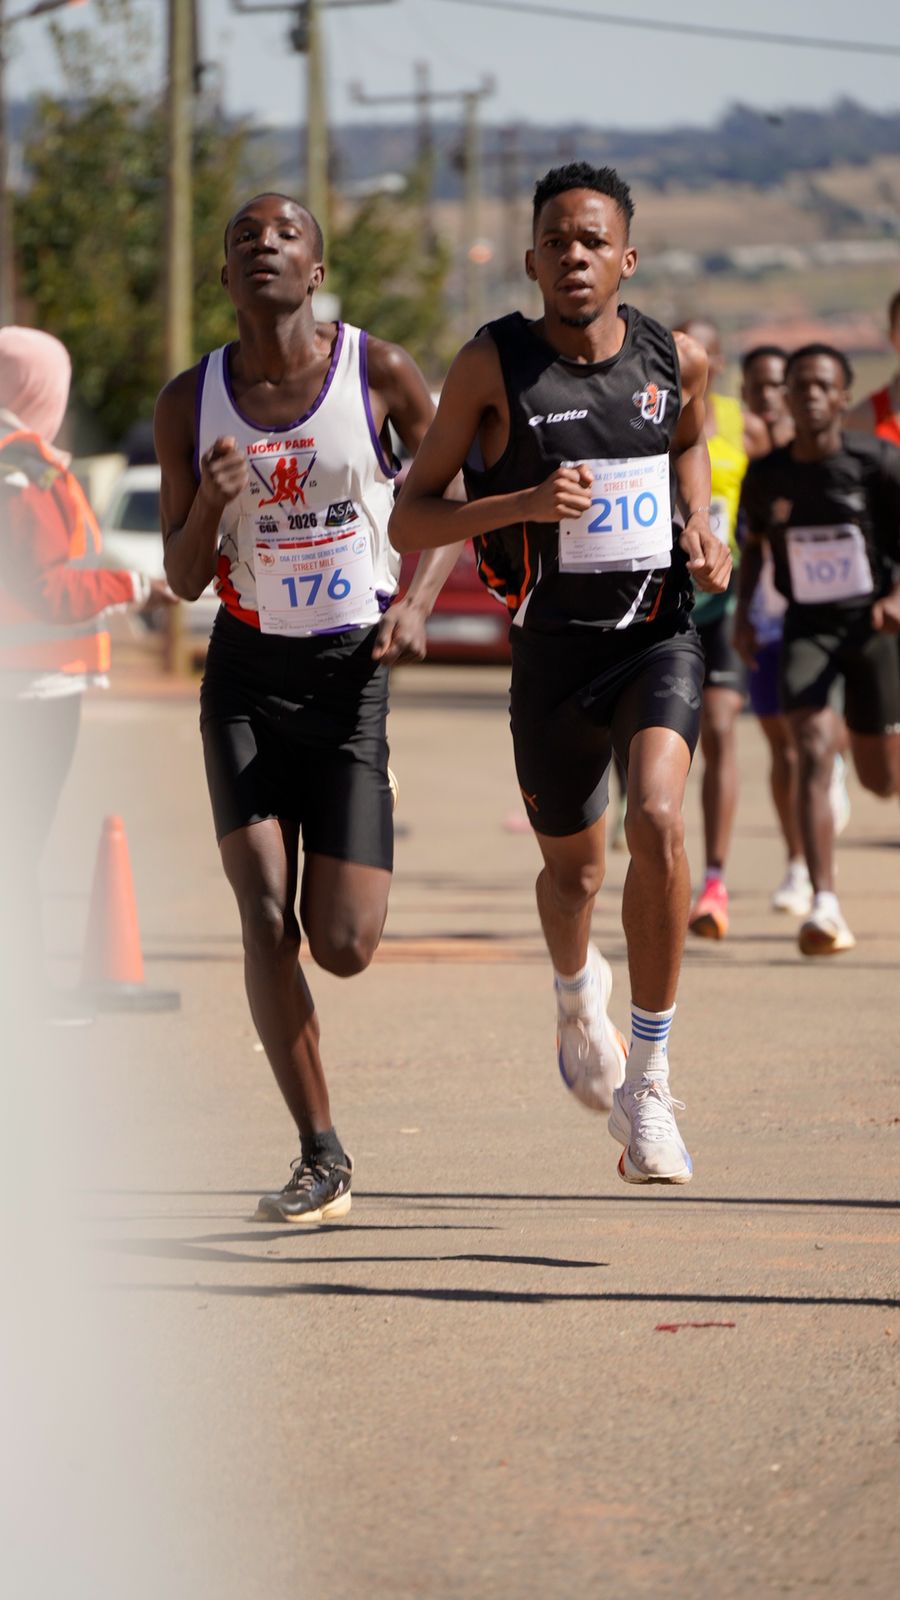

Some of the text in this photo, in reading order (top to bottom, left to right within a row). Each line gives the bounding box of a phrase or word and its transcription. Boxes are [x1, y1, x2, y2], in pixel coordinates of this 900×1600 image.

[640, 389, 670, 425] UJ
[246, 437, 315, 455] IVORY PARK
[604, 478, 643, 492] STREET MILE
[329, 501, 354, 518] ASA
[587, 491, 658, 533] 210
[259, 524, 279, 533] CGA
[288, 512, 318, 530] 2026
[317, 549, 334, 558] SERIES
[335, 544, 348, 553] RUNS
[292, 557, 336, 572] STREET MILE
[804, 557, 850, 585] 107
[281, 568, 351, 608] 176
